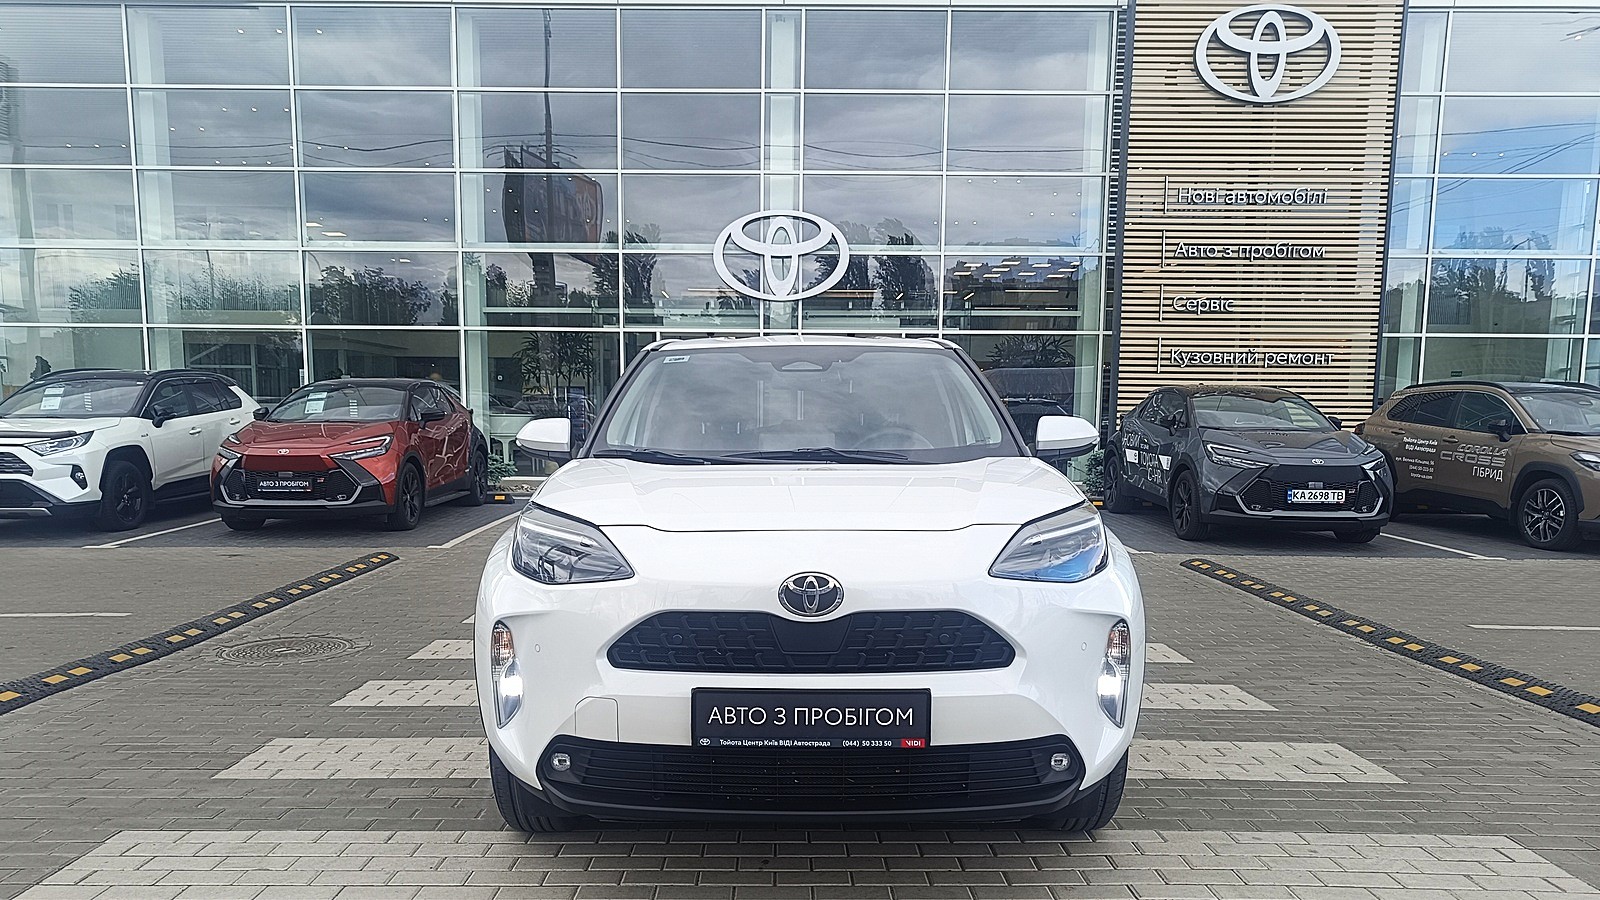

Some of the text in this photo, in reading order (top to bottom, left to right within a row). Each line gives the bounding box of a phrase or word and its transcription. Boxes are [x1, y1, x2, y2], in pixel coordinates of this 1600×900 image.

[1178, 187, 1329, 205] Нові автомобілі
[1174, 241, 1327, 262] Авто з пробігом
[1172, 296, 1235, 315] Сервіс
[1170, 348, 1335, 368] Кузовний ремонт
[1439, 450, 1507, 468] CROSS
[1456, 443, 1509, 457] COROLLA
[1472, 466, 1503, 482] ГІБРИД
[1292, 491, 1306, 500] KA
[1308, 491, 1330, 501] 2698
[1331, 491, 1344, 501] TB
[707, 706, 914, 726] АВТО З ПРОБІГОМ
[742, 739, 763, 747] Центр
[779, 739, 793, 747] ВІДІ
[793, 739, 831, 748] Автострада
[842, 739, 860, 748] (044)
